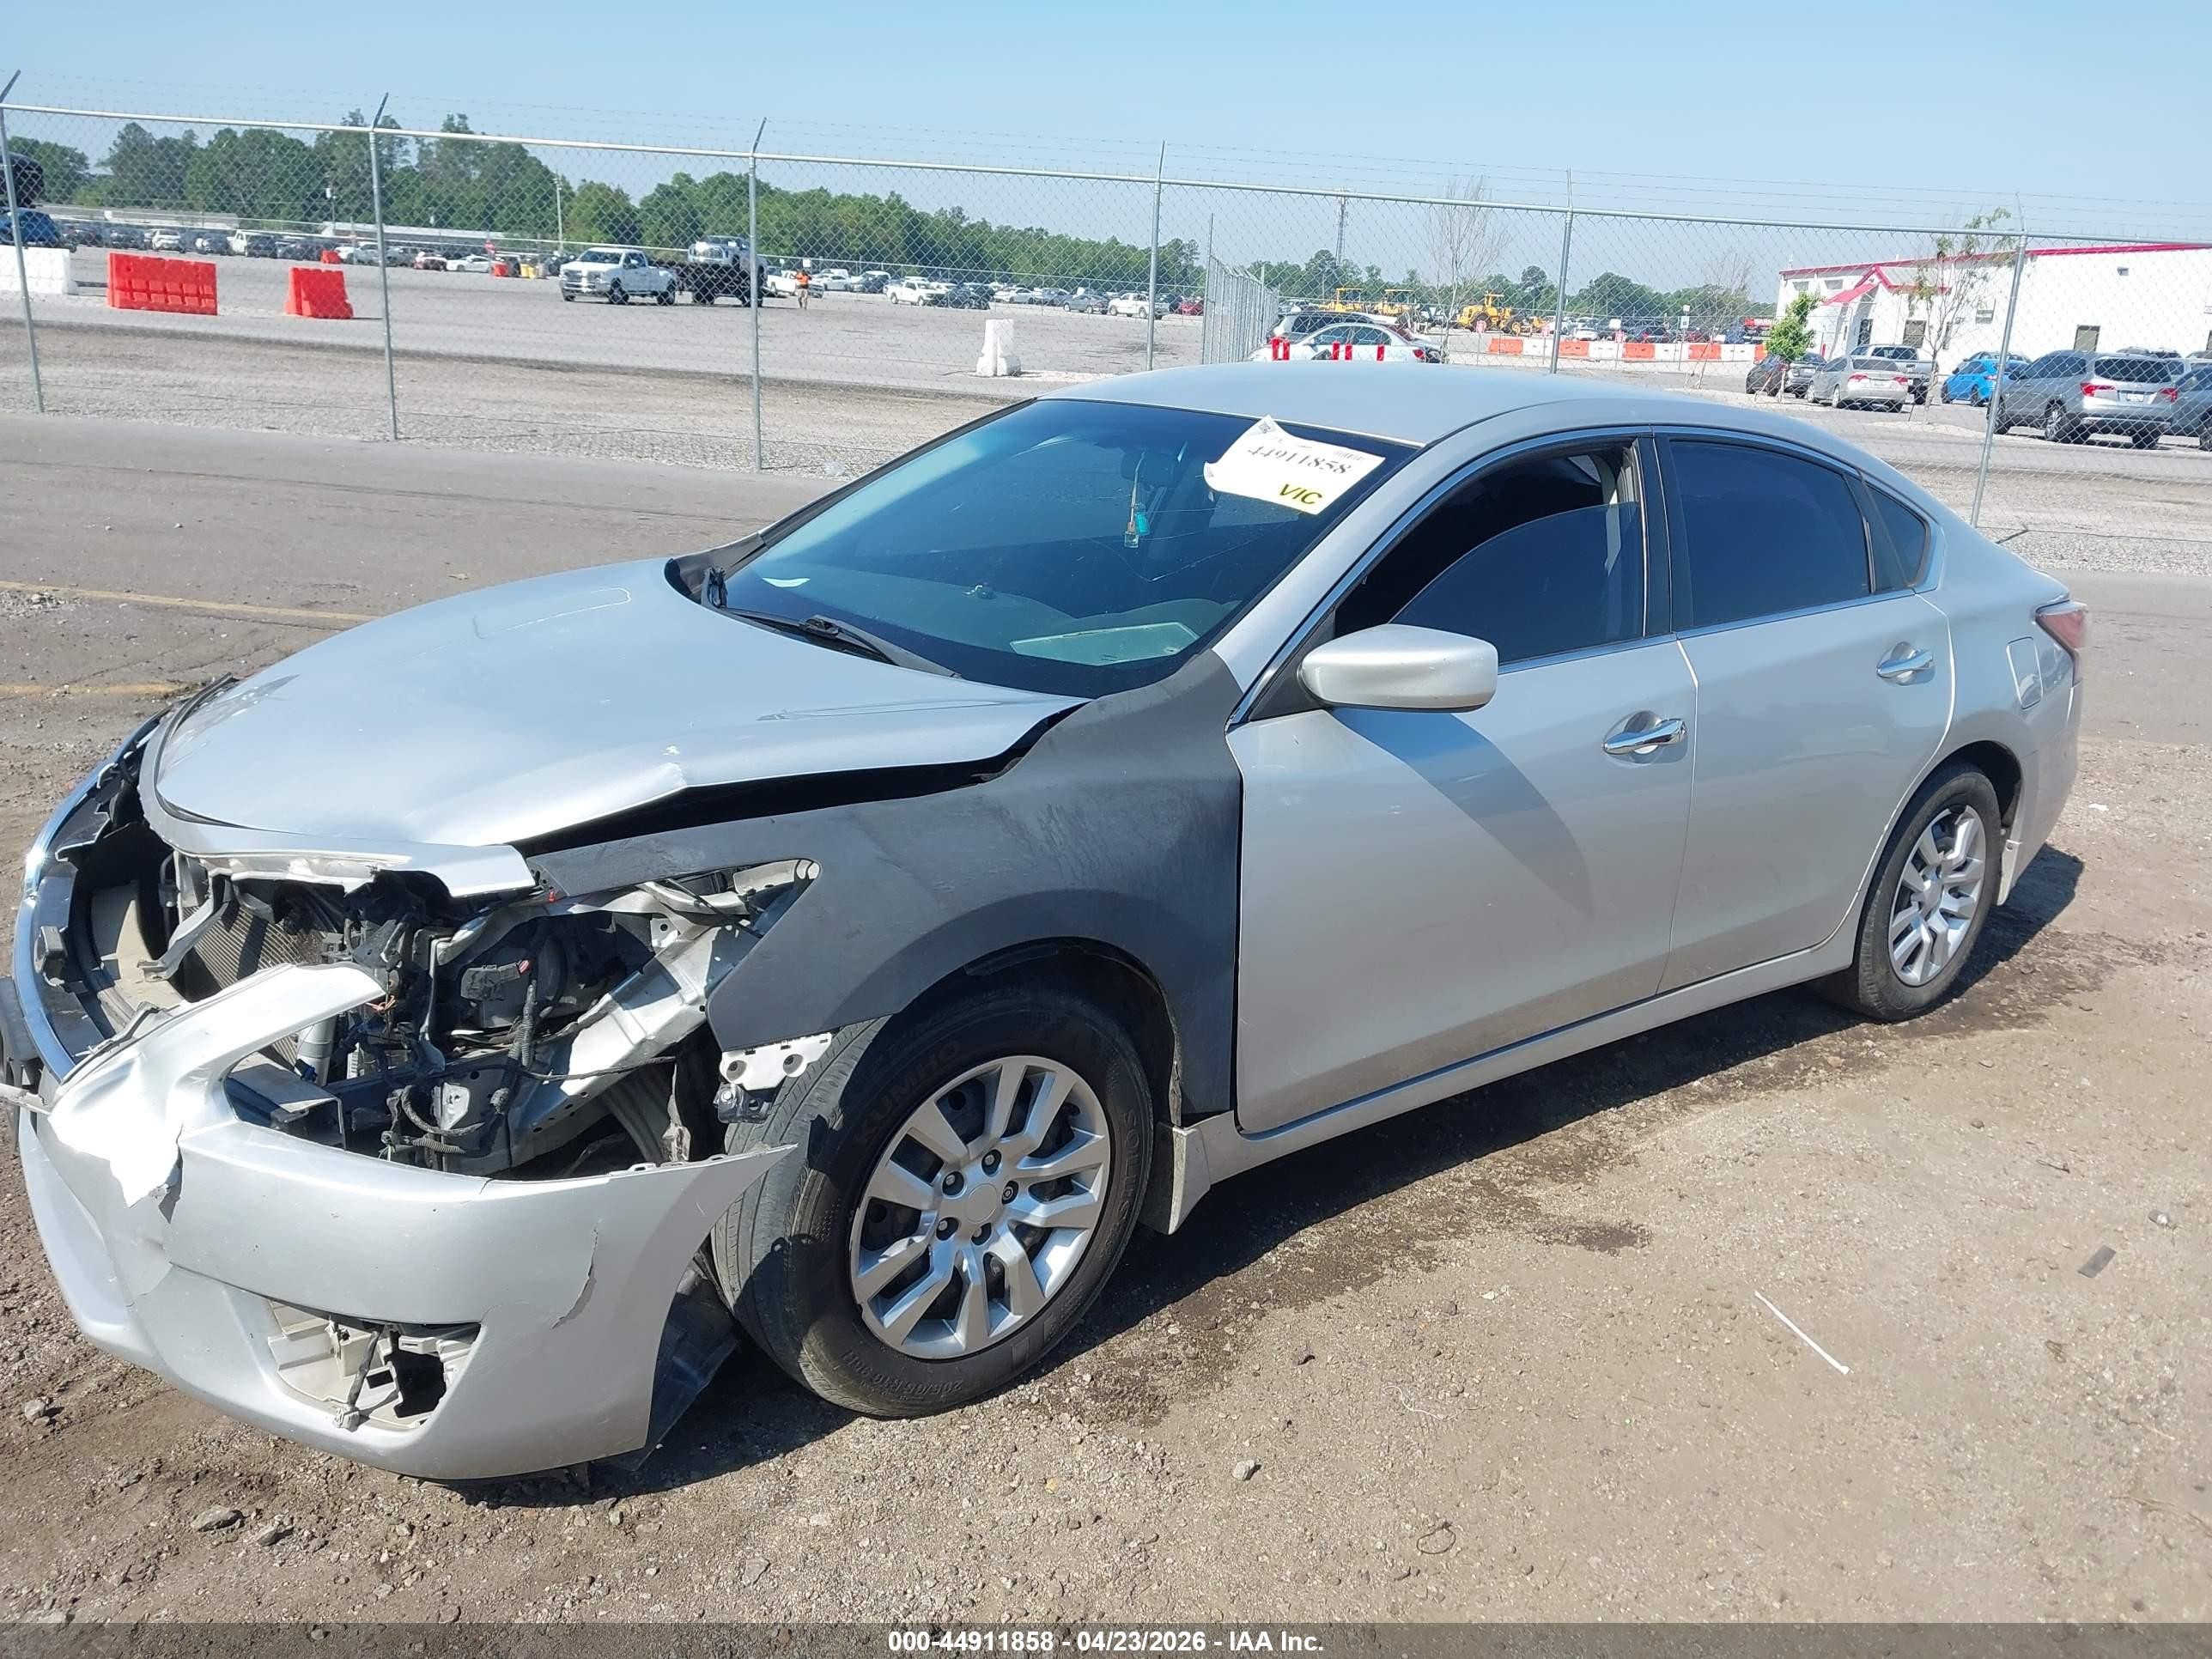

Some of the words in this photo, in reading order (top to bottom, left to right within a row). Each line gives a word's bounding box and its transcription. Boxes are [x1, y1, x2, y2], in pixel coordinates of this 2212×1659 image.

[1248, 445, 1352, 474] 44911858
[1279, 483, 1322, 505] VIC
[1118, 1109, 1140, 1220] SOLUS
